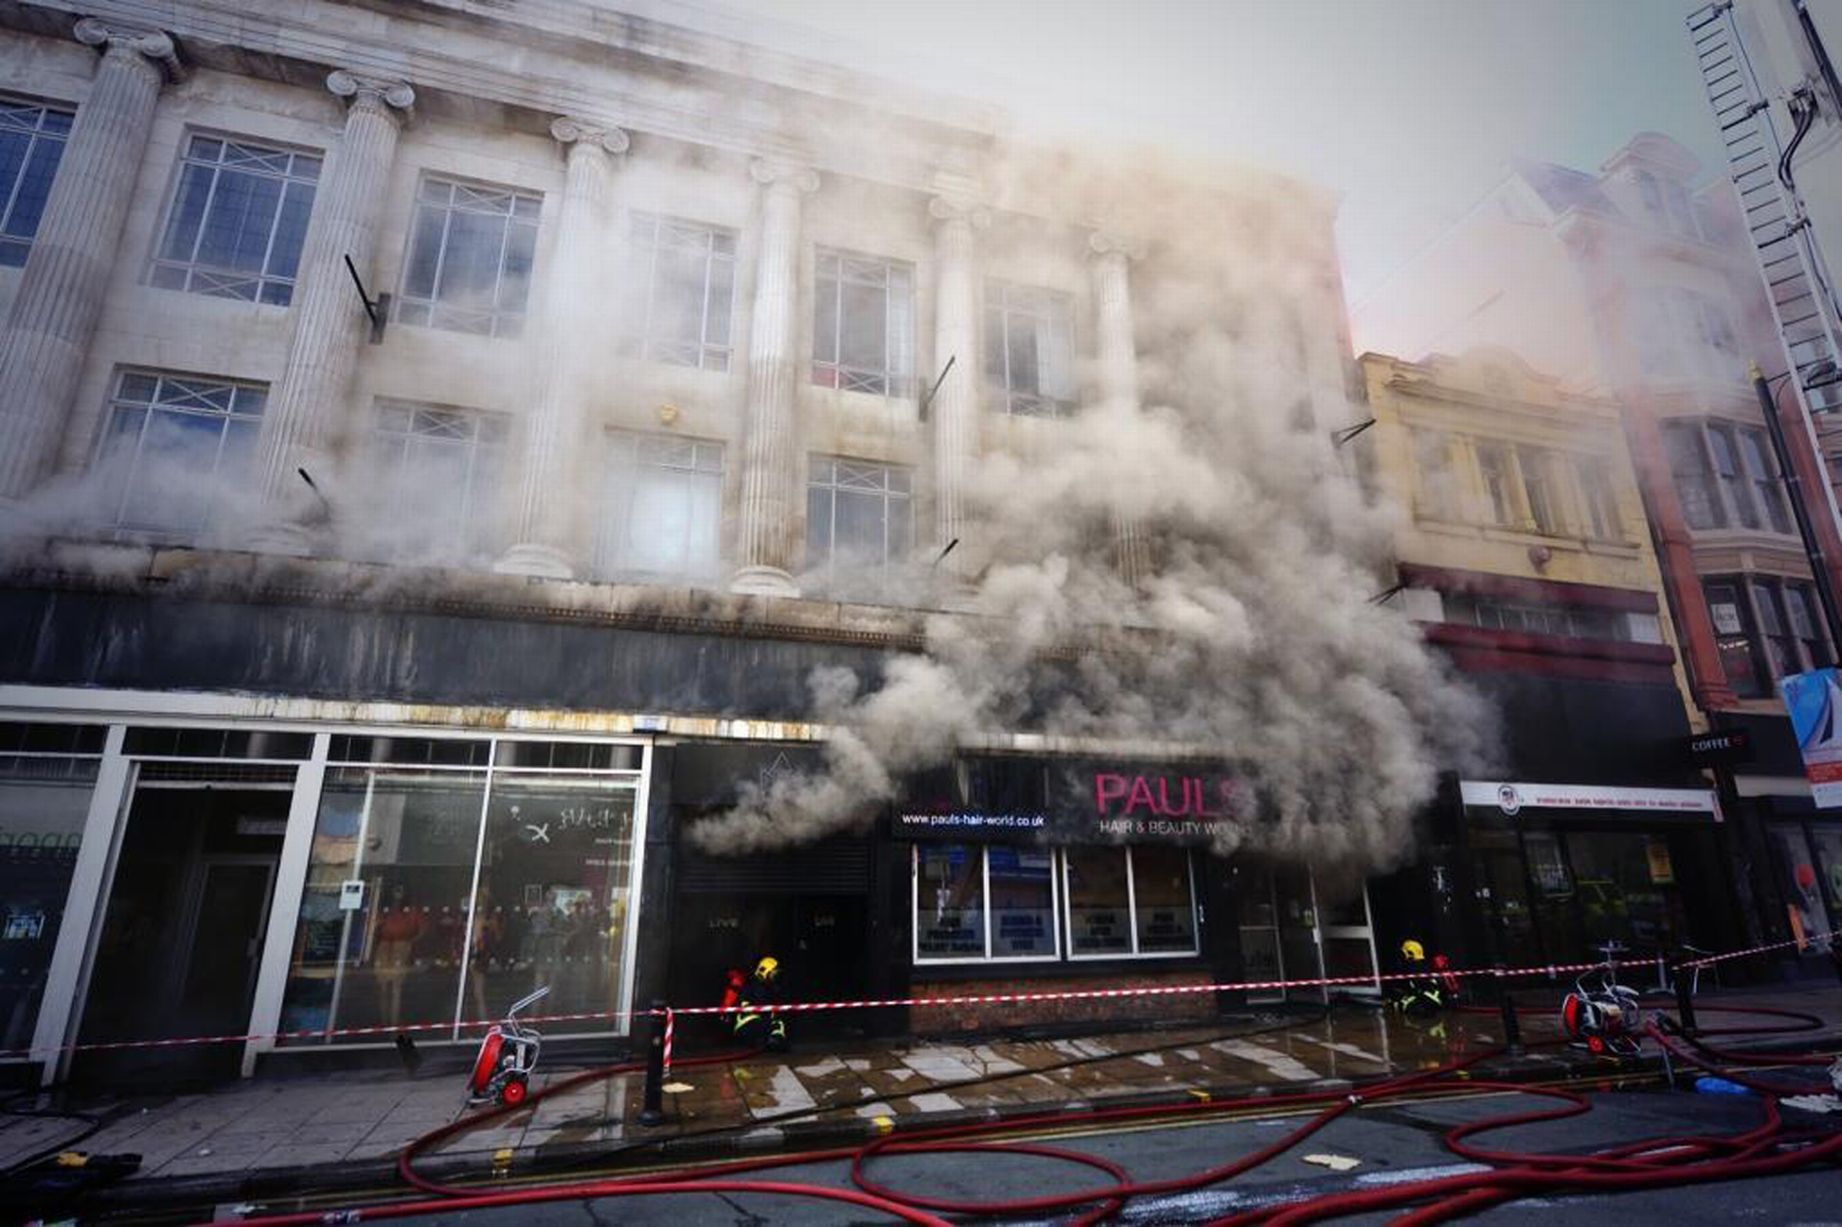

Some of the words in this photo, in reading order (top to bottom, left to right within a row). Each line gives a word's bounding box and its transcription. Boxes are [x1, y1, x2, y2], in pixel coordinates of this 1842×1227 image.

[902, 814, 1045, 827] www.pauls-hair-world.co.uk
[1100, 820, 1133, 834] HAIR
[1136, 821, 1145, 834] &
[1148, 821, 1201, 835] BEAUTY
